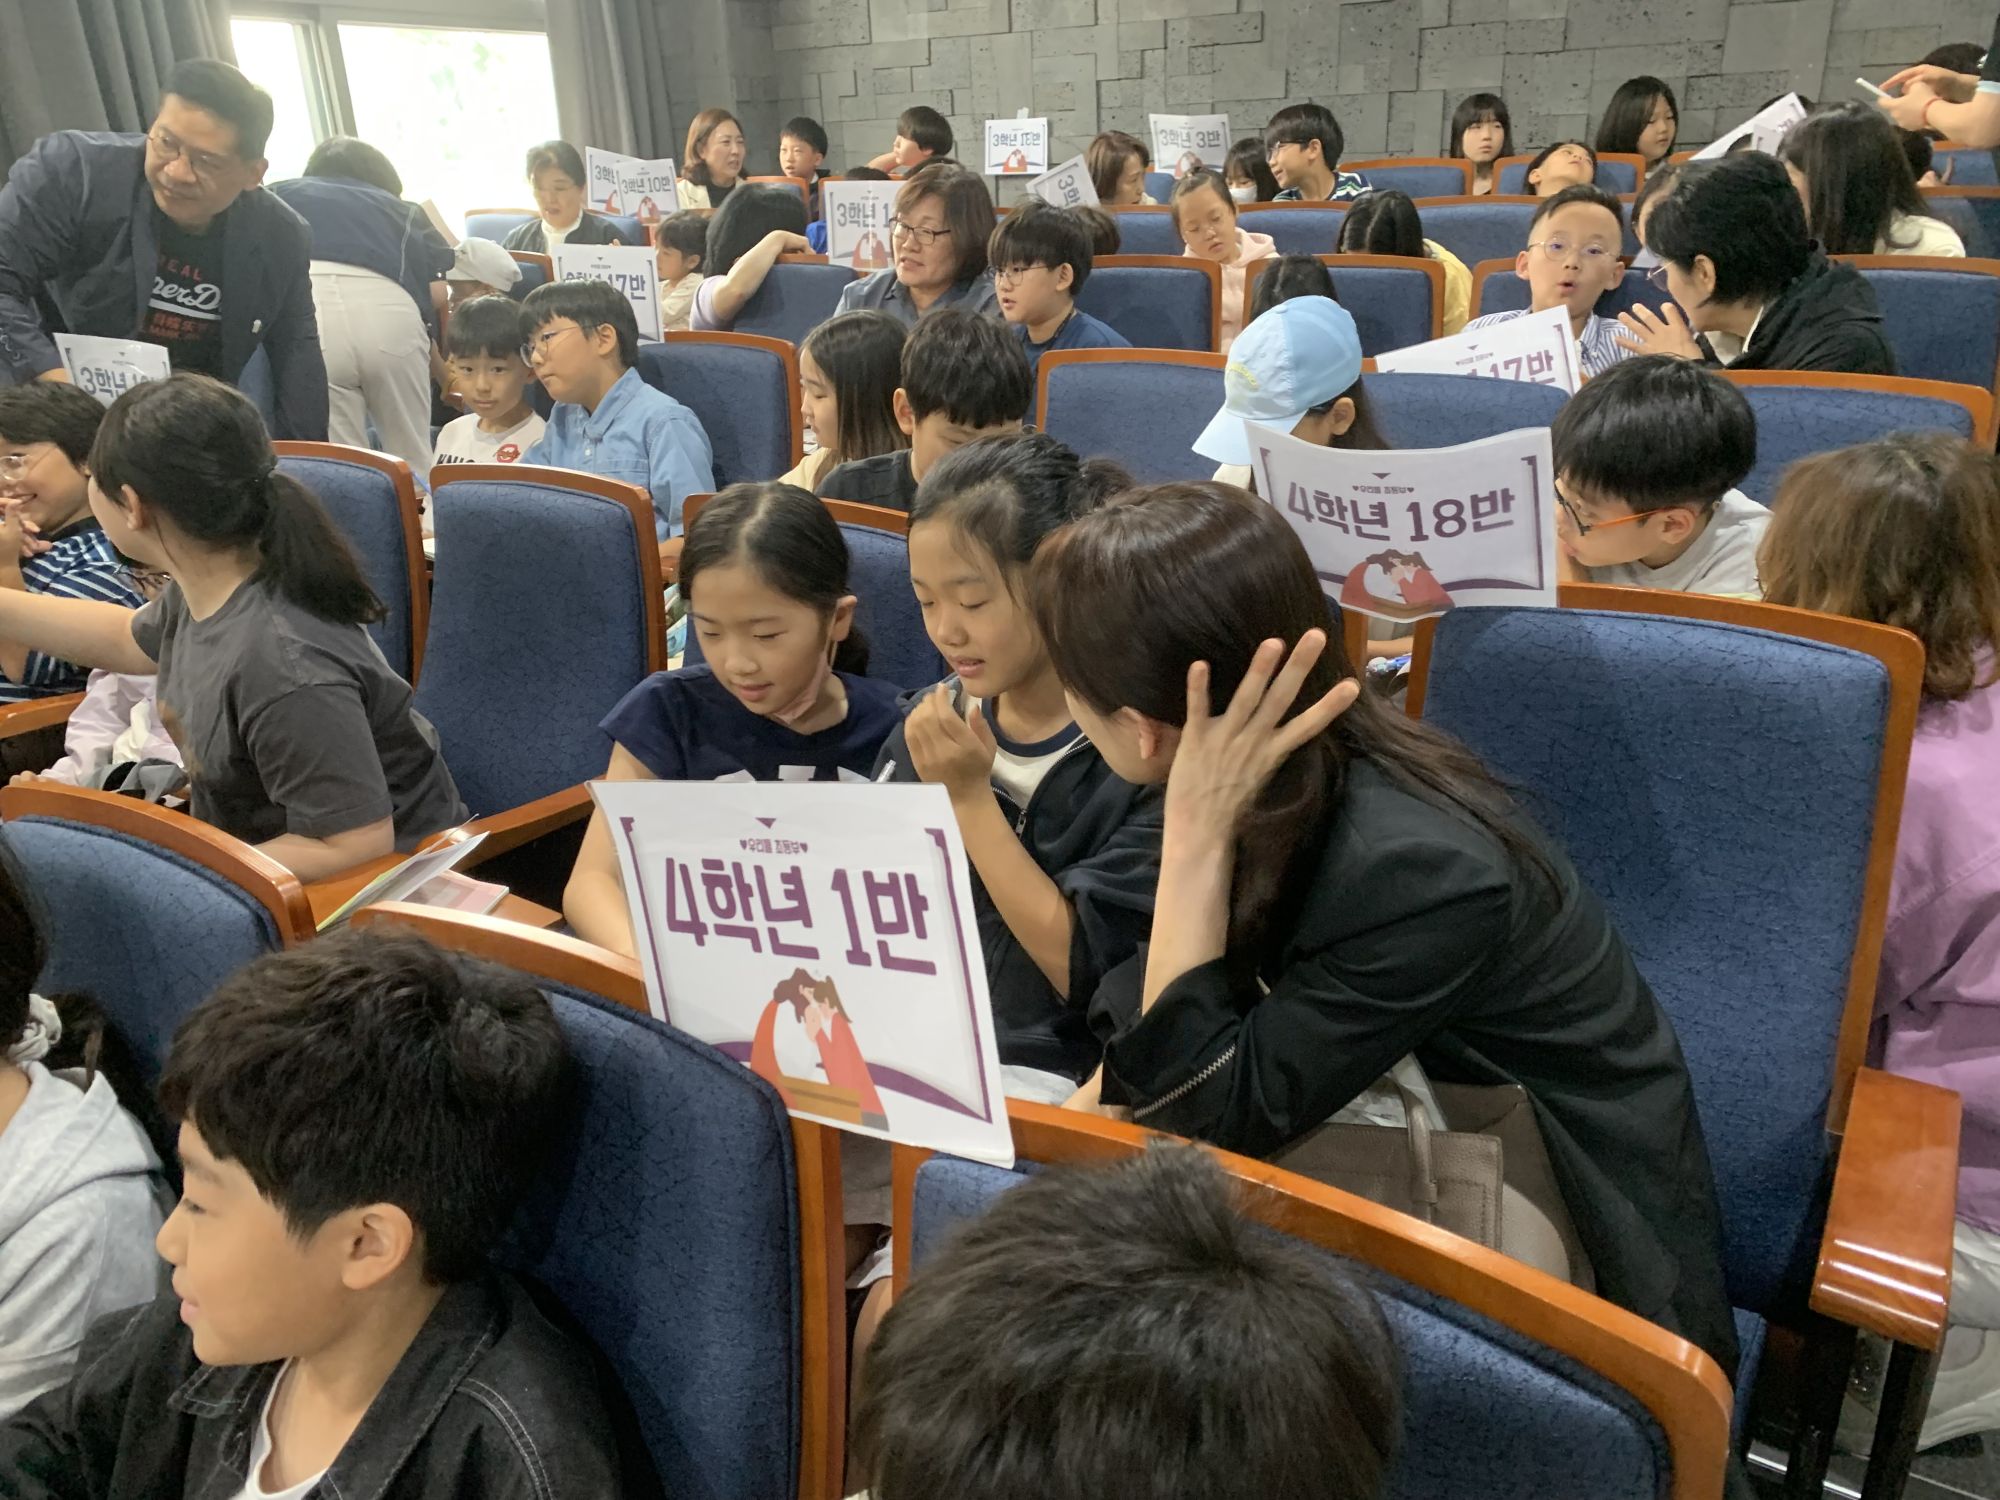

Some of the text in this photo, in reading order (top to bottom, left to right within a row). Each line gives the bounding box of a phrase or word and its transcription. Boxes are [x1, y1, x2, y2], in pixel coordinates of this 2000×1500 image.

[993, 133, 1017, 147] 3학년
[1160, 129, 1221, 148] 3학년 3반
[622, 175, 672, 194] 3학년 10반
[836, 202, 876, 228] 3학년
[1288, 482, 1516, 542] 4학년 18반
[665, 857, 937, 976] 4학년 1반
